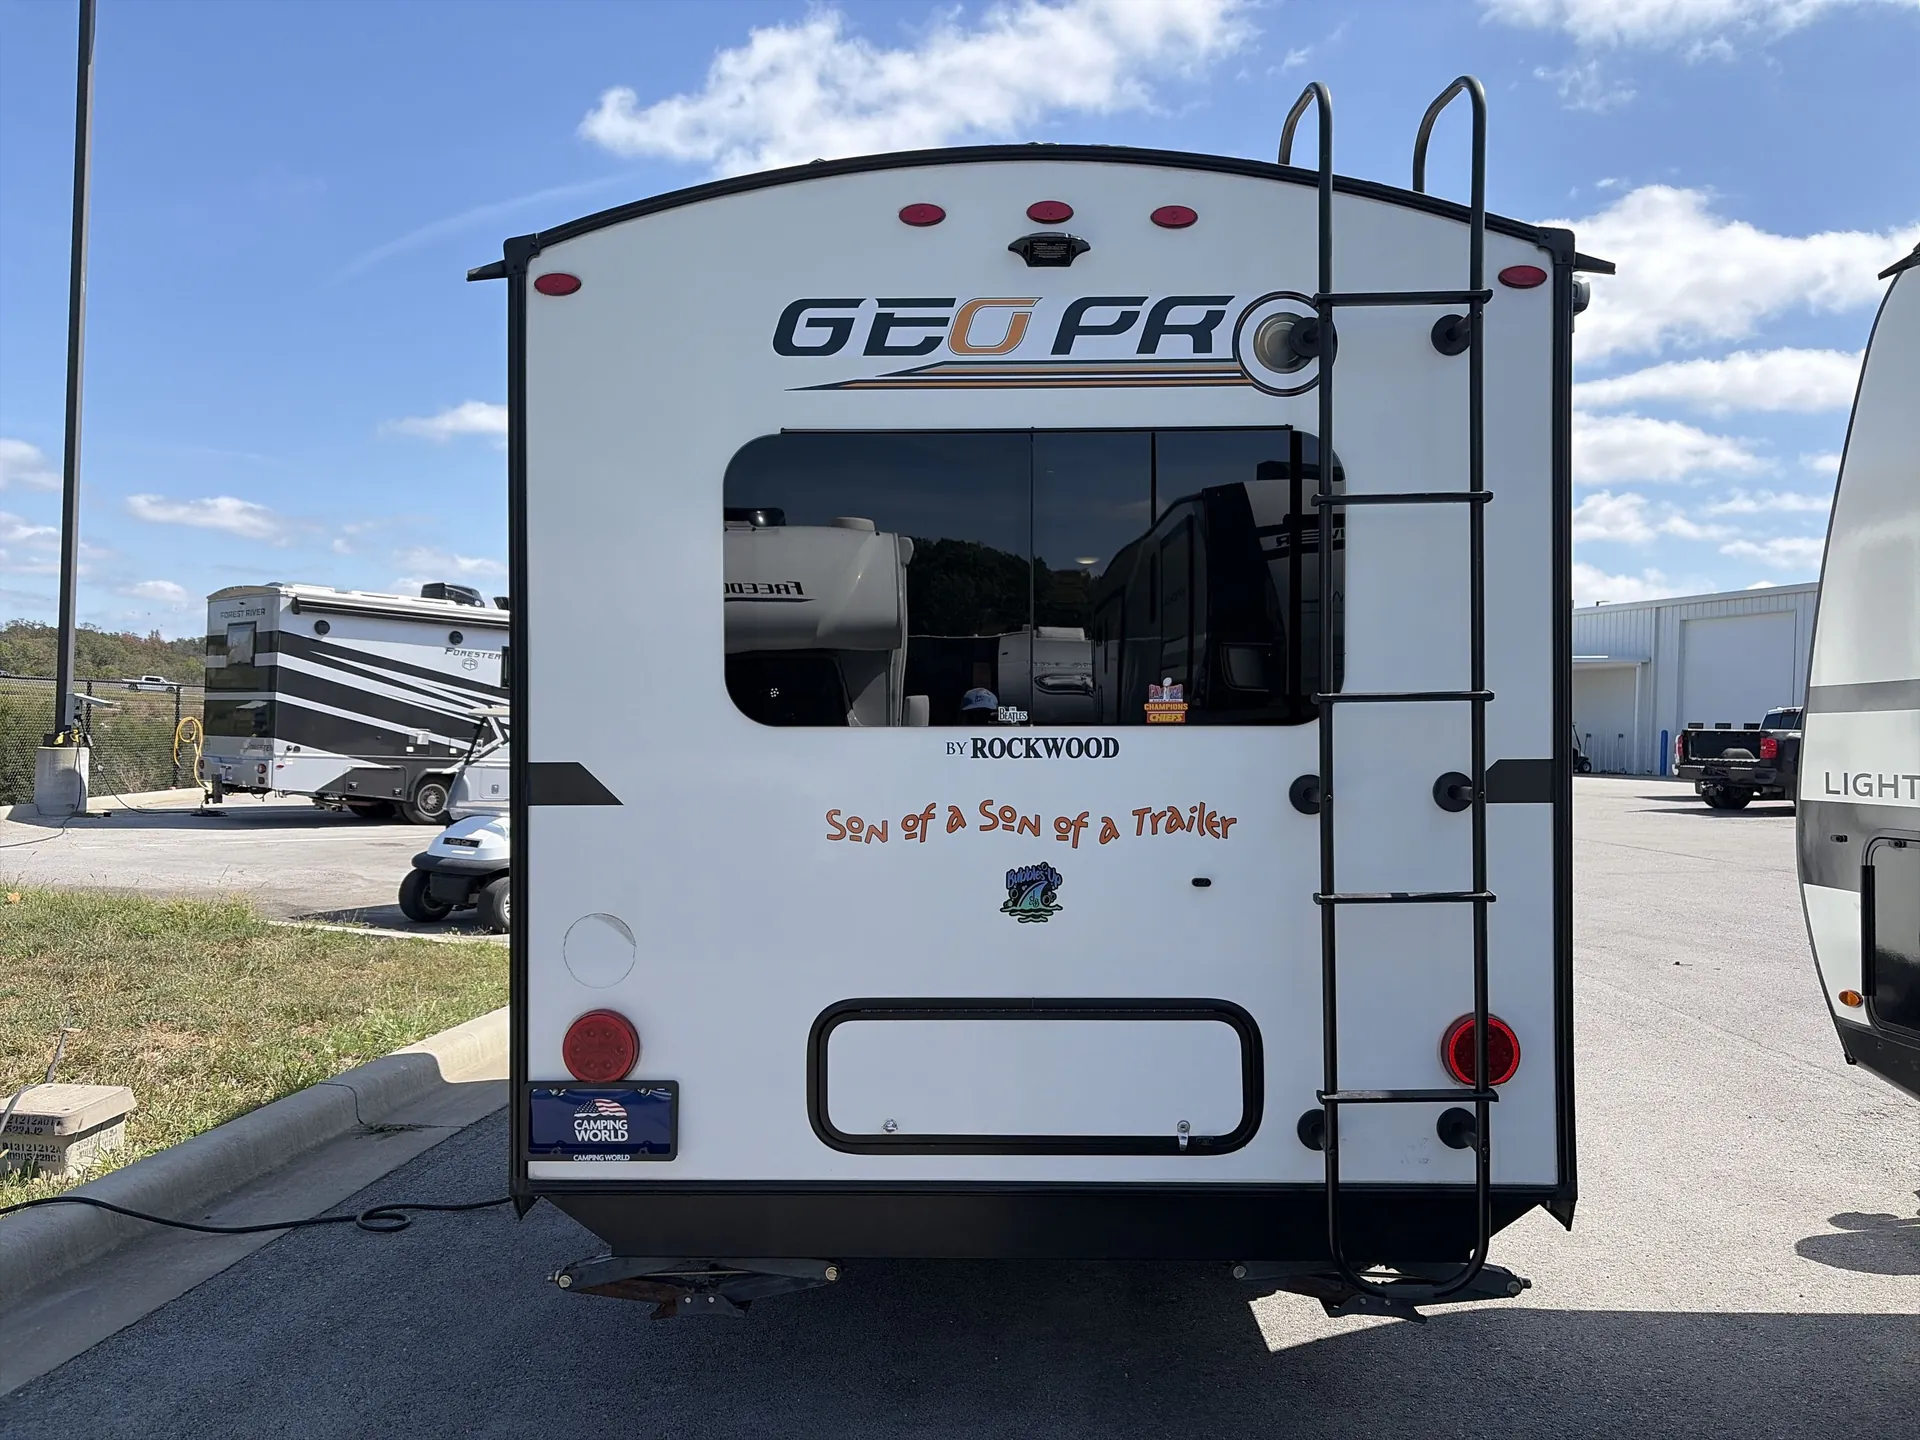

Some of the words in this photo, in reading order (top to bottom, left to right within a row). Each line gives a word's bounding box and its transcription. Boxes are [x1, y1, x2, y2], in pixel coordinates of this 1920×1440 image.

[772, 296, 1043, 357] GEO
[220, 610, 244, 619] FOREST
[245, 607, 266, 617] RIVER
[444, 647, 501, 660] FORESTER
[1149, 713, 1183, 722] CHIEFS
[945, 741, 968, 755] BY
[970, 737, 1119, 759] ROCKWOOD
[1825, 771, 1920, 800] LIGHT
[901, 802, 936, 843] of
[946, 805, 967, 833] a
[1053, 811, 1089, 848] of
[1099, 816, 1120, 844] a
[573, 1119, 628, 1130] CAMPING
[575, 1130, 628, 1142] WORLD
